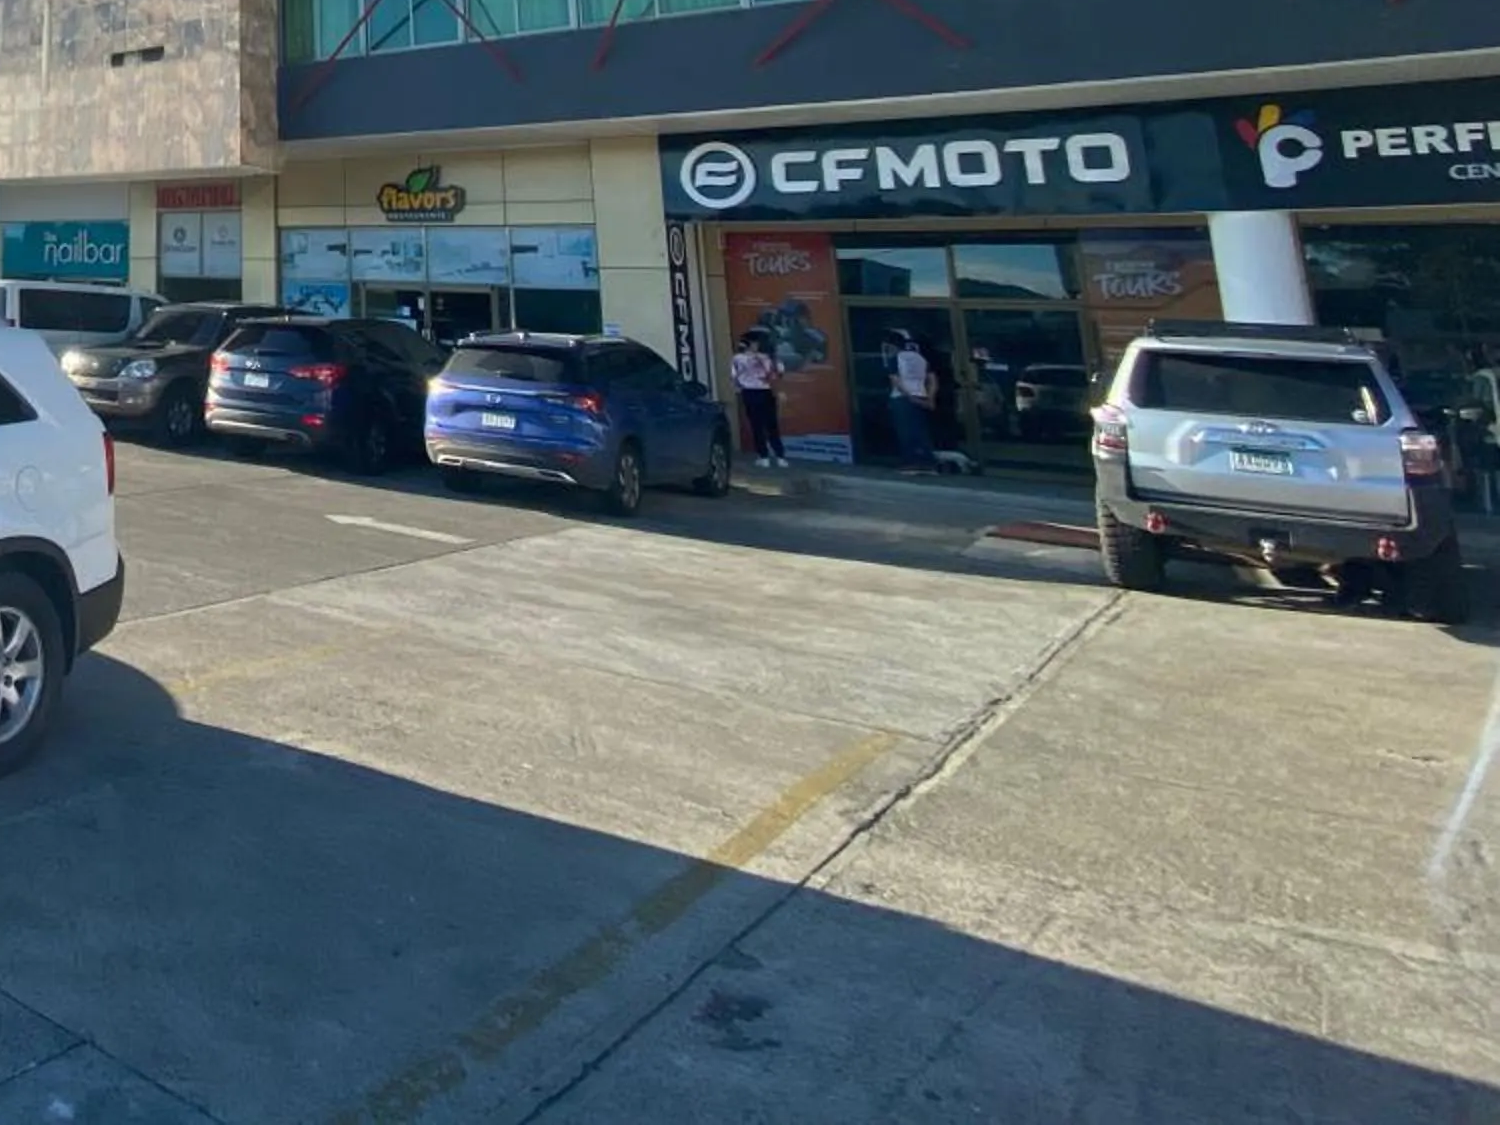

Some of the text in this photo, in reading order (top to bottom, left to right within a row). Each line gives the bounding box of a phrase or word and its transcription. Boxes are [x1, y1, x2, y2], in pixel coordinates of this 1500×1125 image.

[771, 133, 1130, 193] CFMOTO
[43, 227, 125, 267] nailbar
[674, 272, 693, 382] CFMO
